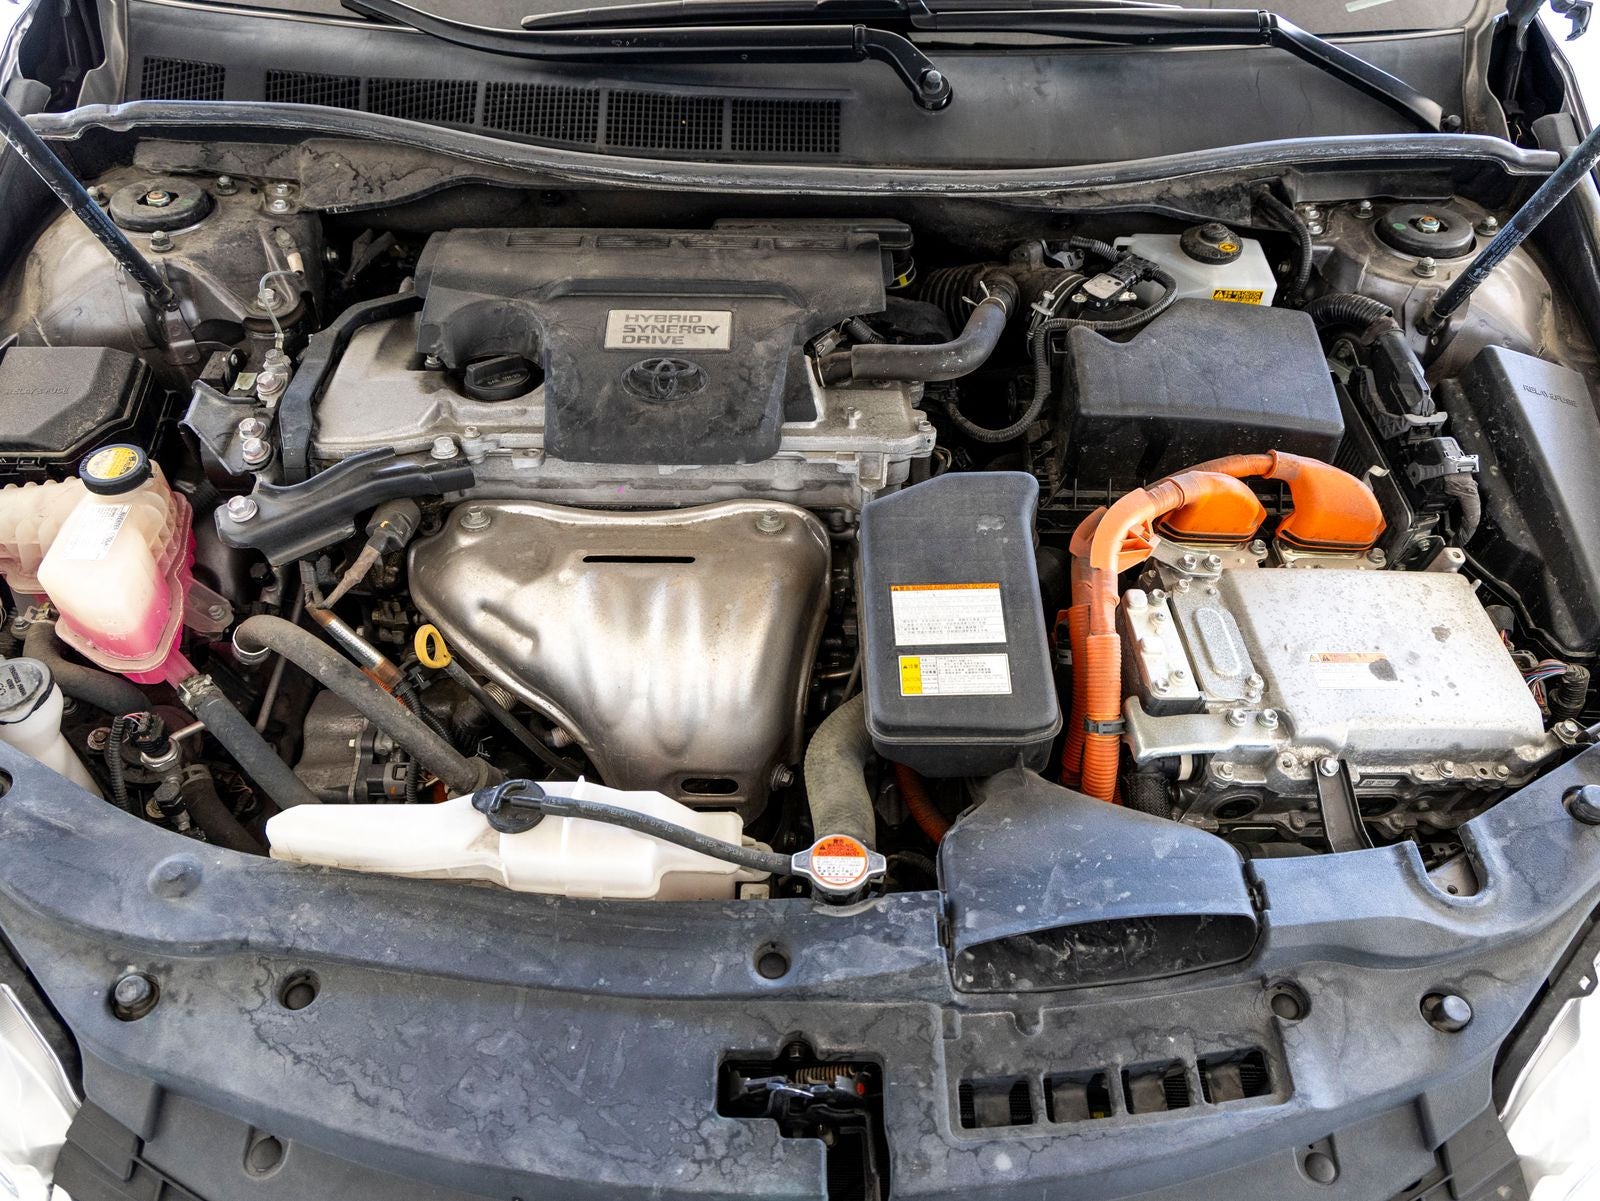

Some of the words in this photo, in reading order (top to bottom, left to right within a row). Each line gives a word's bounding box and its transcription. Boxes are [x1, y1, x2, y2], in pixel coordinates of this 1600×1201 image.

[624, 314, 702, 323] HYBRID
[622, 324, 720, 334] SYNERGY
[621, 335, 685, 345] DRIVE
